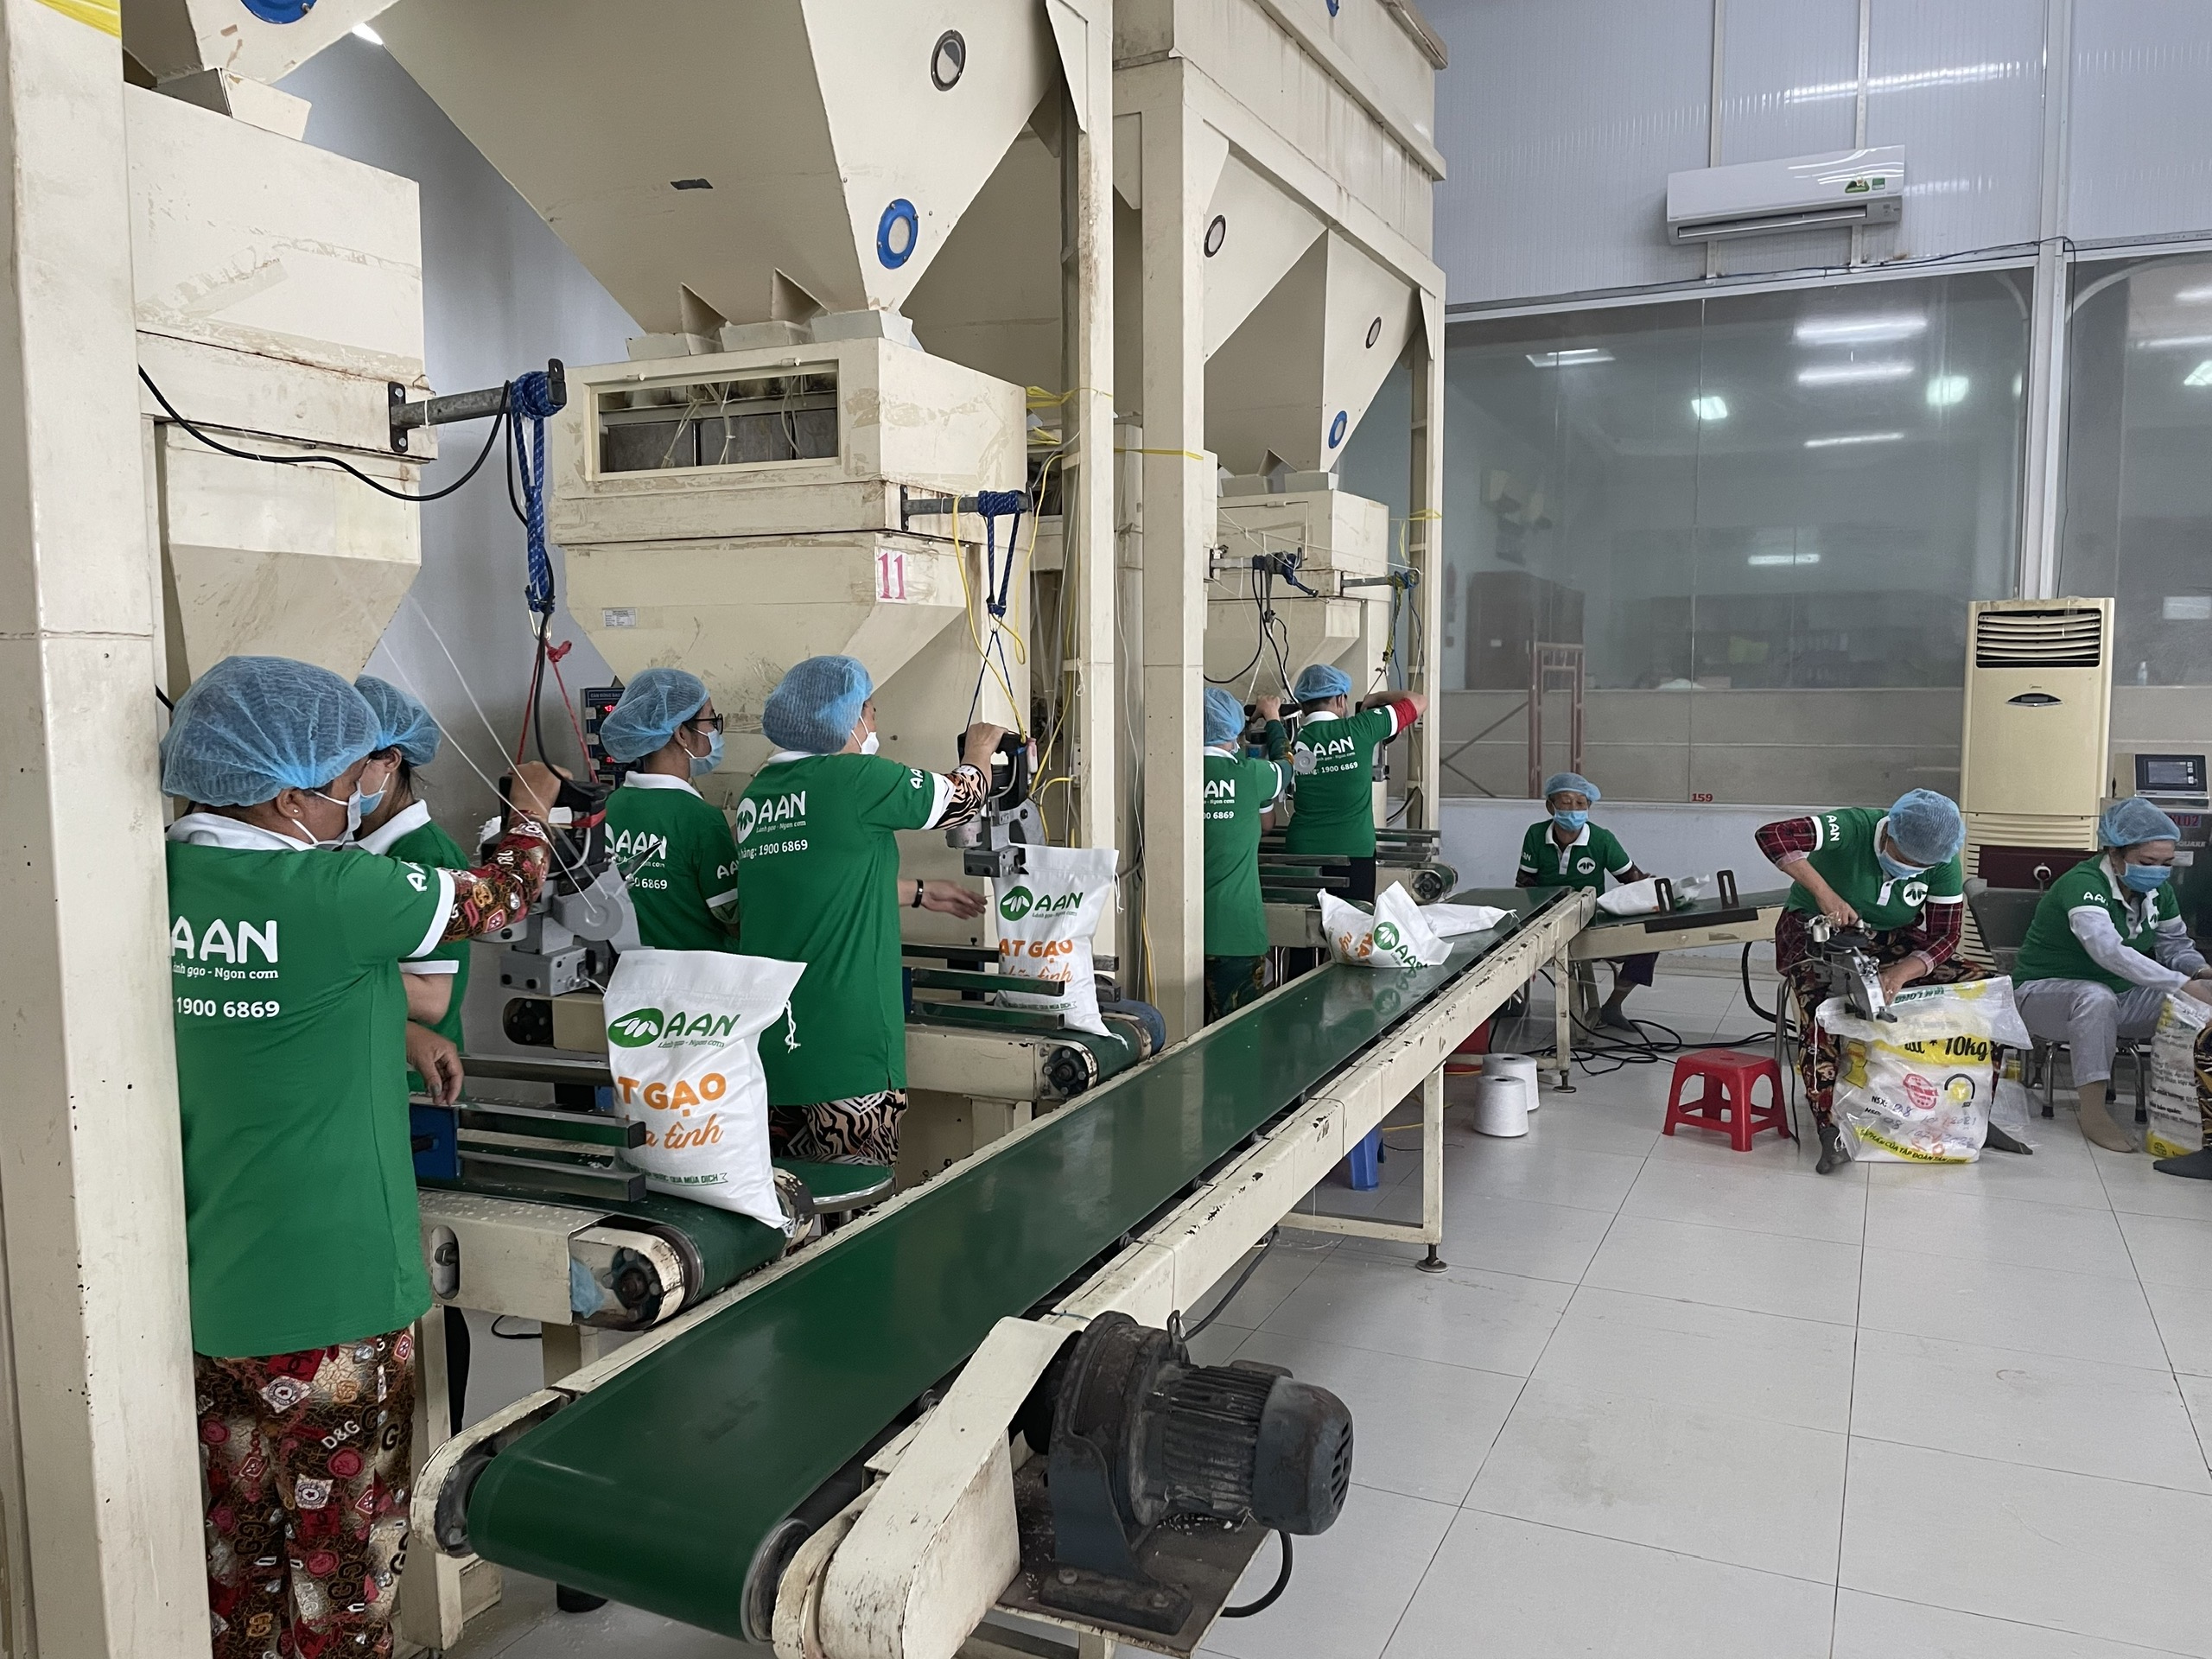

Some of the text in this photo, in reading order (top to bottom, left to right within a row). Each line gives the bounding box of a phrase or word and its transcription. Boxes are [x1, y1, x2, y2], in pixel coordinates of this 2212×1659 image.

[878, 552, 907, 600] 11
[1313, 736, 1354, 756] AAN
[1321, 765, 1338, 773] 1900
[1340, 761, 1358, 771] 6869
[910, 768, 924, 789] AA
[1204, 779, 1236, 798] AN
[758, 790, 806, 825] AAN
[1692, 793, 1713, 802] 159
[1212, 810, 1235, 819] 6869
[1826, 815, 1840, 842] AAN
[615, 829, 667, 860] AAN
[759, 842, 779, 855] 1900
[782, 839, 808, 853] 6869
[716, 859, 739, 880] AA
[641, 877, 668, 890] 6869
[1034, 891, 1084, 912] AAN
[171, 915, 278, 963] AAN
[1028, 938, 1073, 963] GẠO
[187, 966, 206, 978] gạo
[214, 967, 246, 981] Ngon
[176, 996, 280, 1018] 1900 6869
[663, 1011, 741, 1039] AAN
[1945, 1036, 1989, 1062] 10kg
[643, 1072, 727, 1117] GẠO
[1871, 1096, 1887, 1107] NSX:
[664, 1113, 724, 1149] tình
[1885, 1141, 1899, 1152] CỦA
[321, 1420, 360, 1450] D&G
